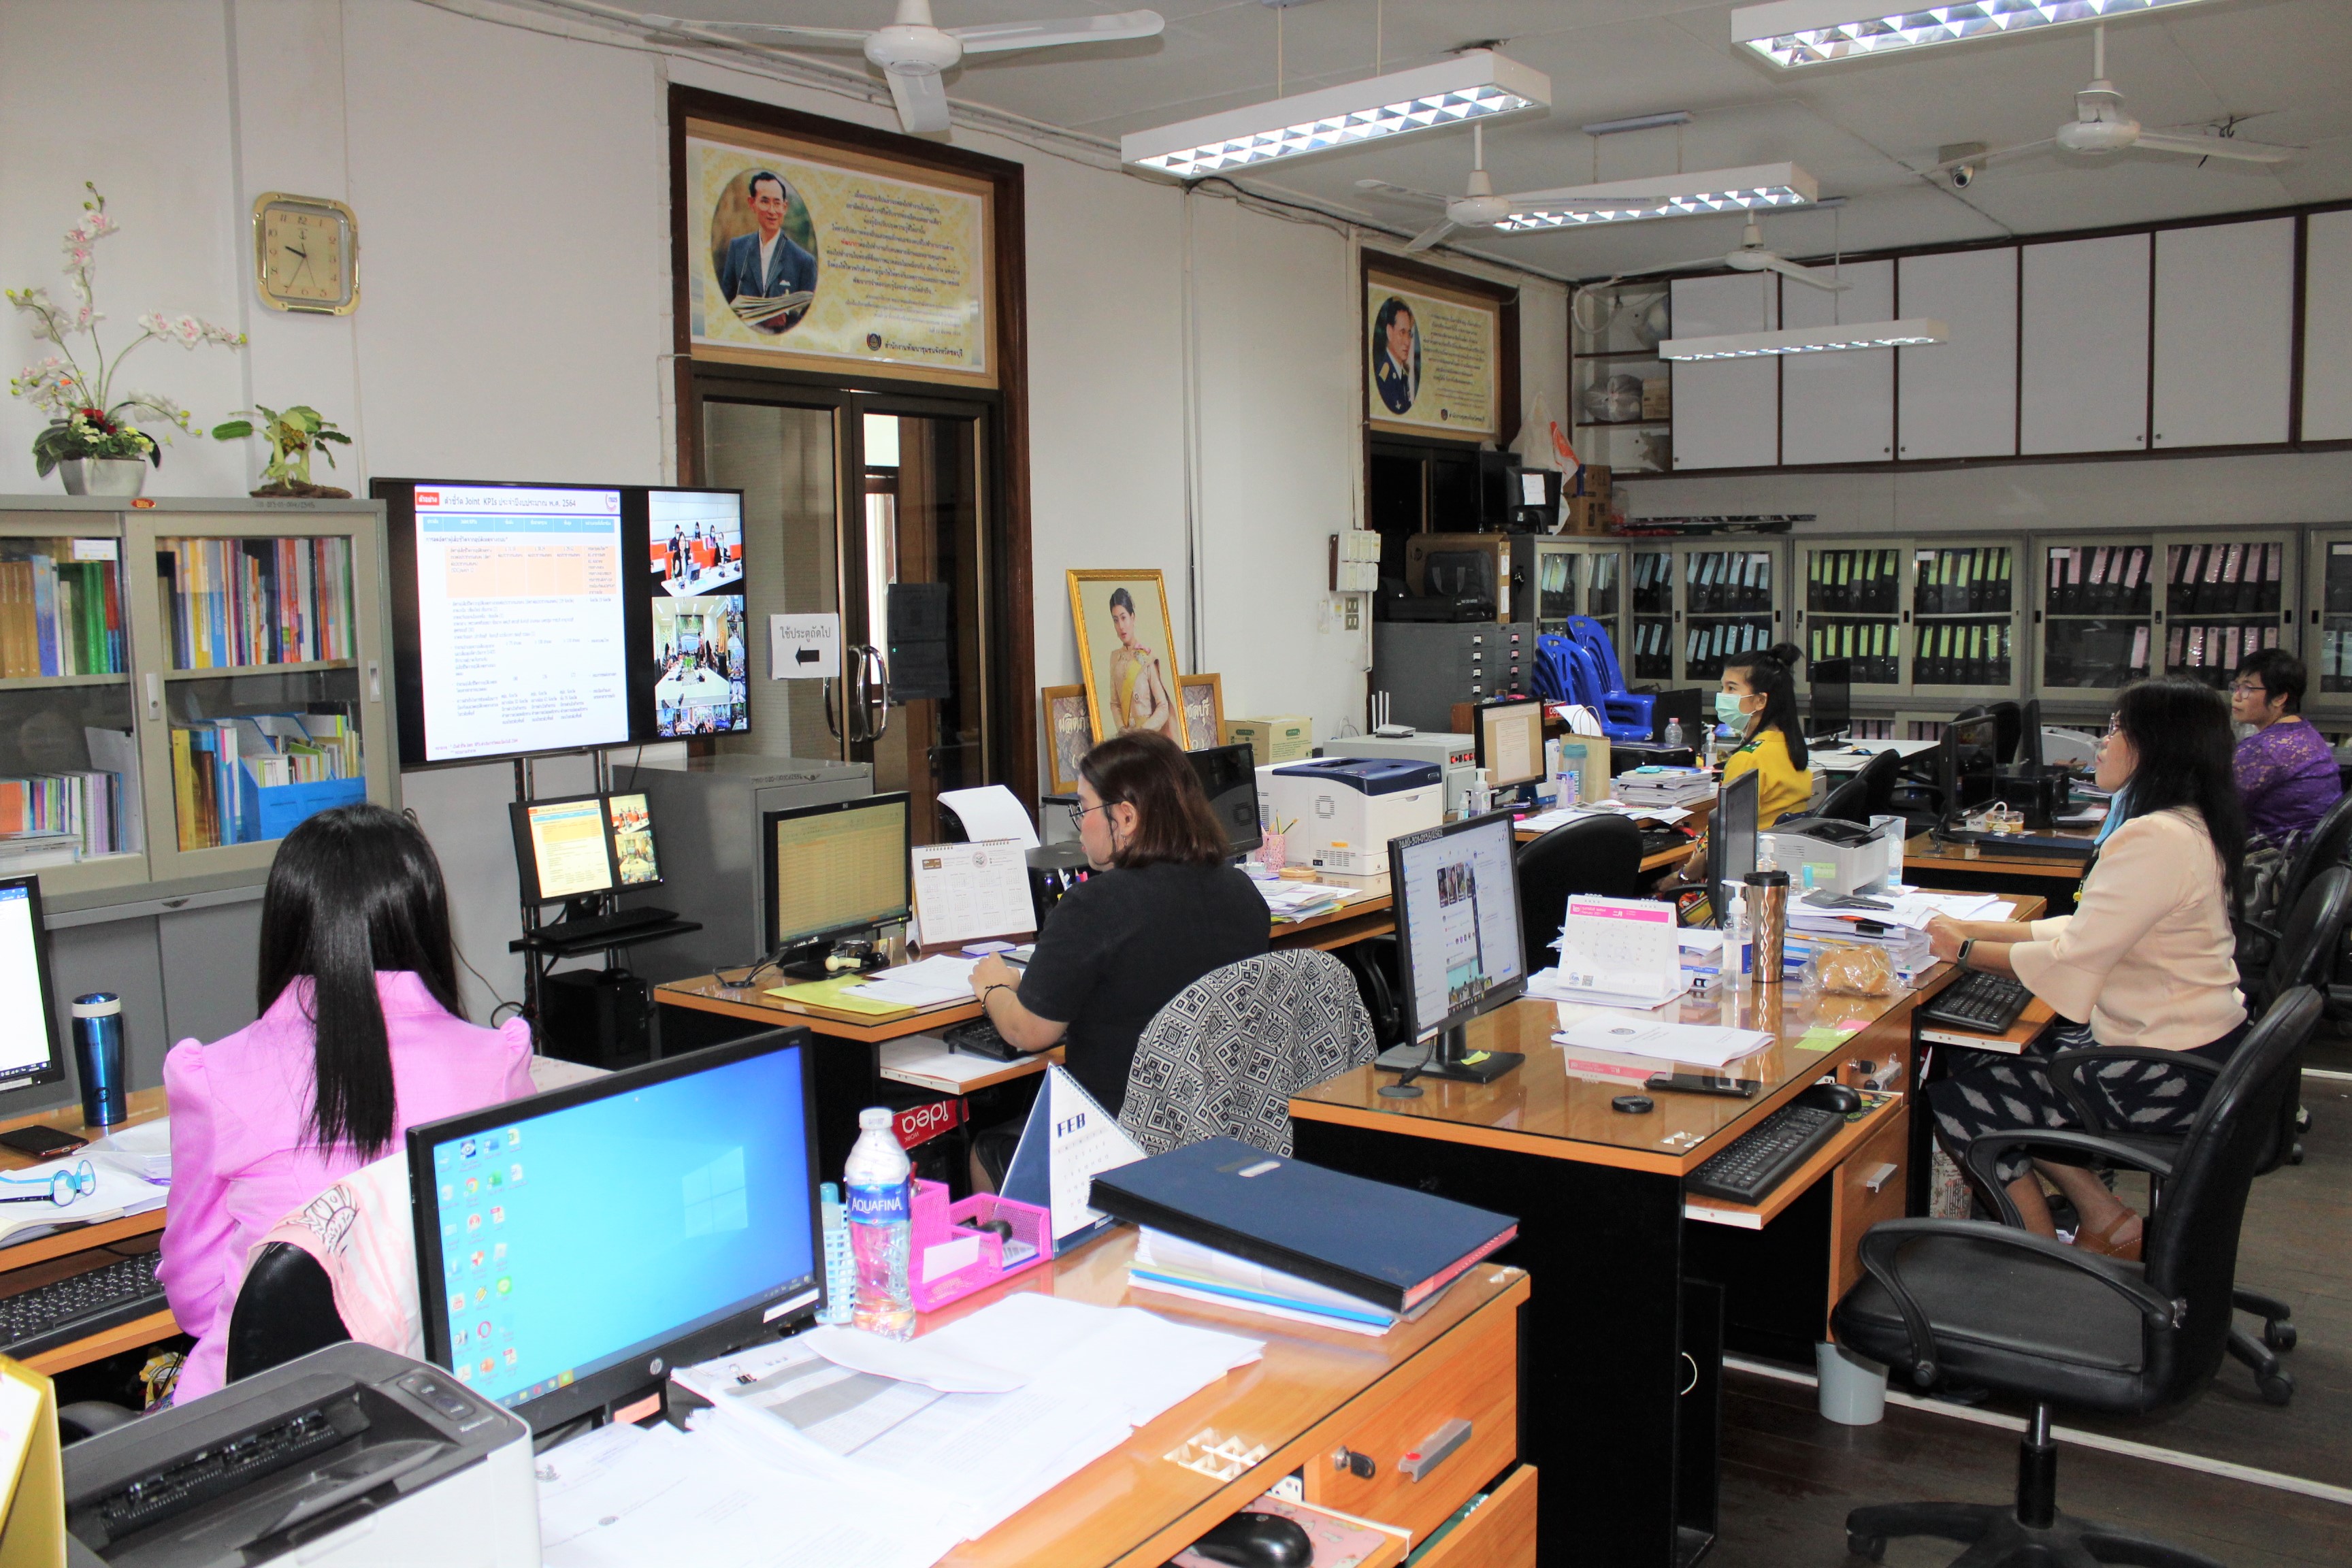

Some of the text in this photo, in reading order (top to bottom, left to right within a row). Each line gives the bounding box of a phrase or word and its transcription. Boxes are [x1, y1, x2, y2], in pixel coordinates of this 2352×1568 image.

[499, 497, 548, 507] ประจำปีงบประมาณ
[779, 625, 831, 642] ใช้ประตูถัดไป
[902, 1100, 948, 1133] idea
[1056, 1112, 1085, 1138] FEB
[852, 1197, 902, 1214] AQUAFINA
